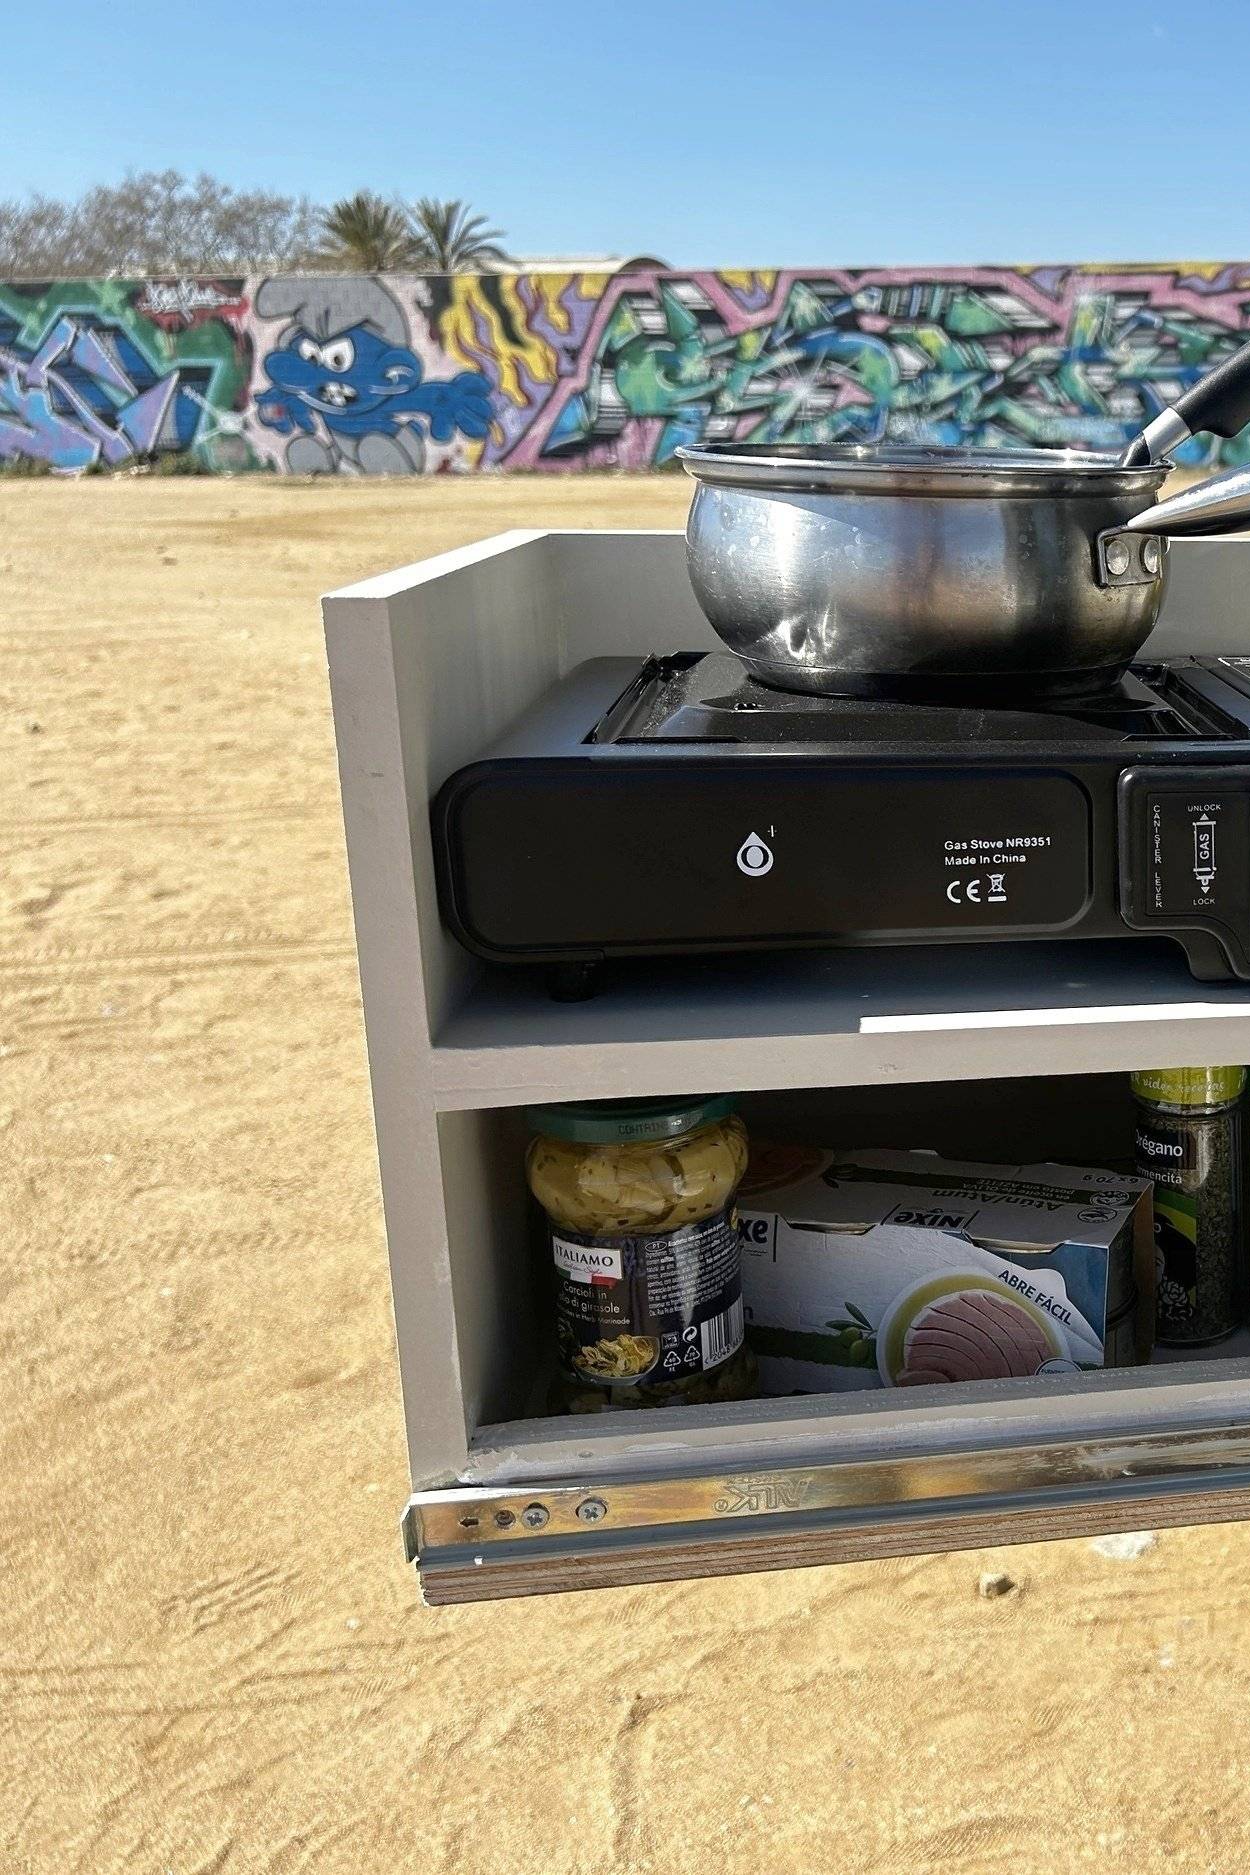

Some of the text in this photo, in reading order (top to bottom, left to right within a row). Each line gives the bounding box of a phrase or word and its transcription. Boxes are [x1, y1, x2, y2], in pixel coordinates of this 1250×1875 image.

[1187, 803, 1221, 812] UNLOCK
[944, 836, 1052, 851] Gas Stove NR9351
[1153, 805, 1162, 864] CANISTER
[1199, 833, 1210, 860] GAS
[944, 852, 1026, 866] Made In China
[1193, 898, 1216, 906] LOCK
[932, 1189, 1064, 1212] Atún/Atum
[555, 1244, 613, 1267] ITALIAMO
[998, 1269, 1072, 1326] ABRE FÁCIL
[581, 1302, 620, 1314] girasole
